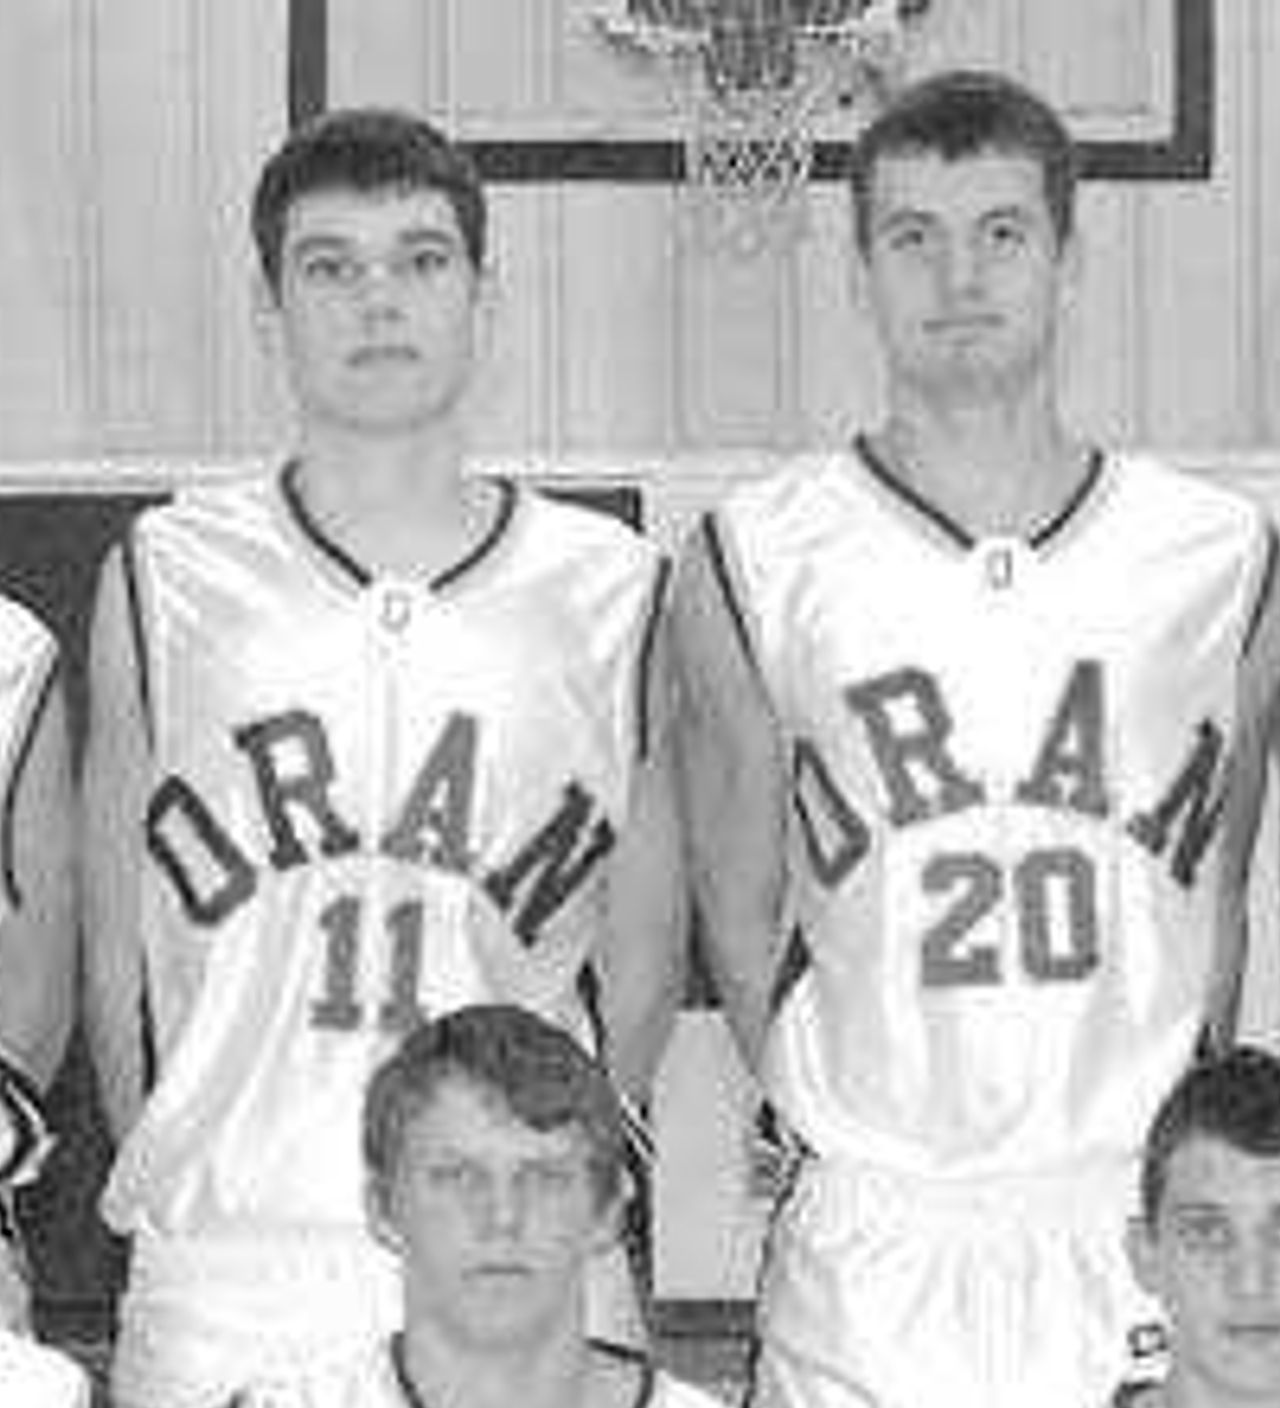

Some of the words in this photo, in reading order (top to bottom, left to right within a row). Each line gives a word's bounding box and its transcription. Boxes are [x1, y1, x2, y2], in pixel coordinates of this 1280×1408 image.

[147, 709, 615, 947] ORAN
[794, 659, 1223, 889] ORAN
[310, 895, 426, 1031] 11
[921, 848, 1097, 987] 20
